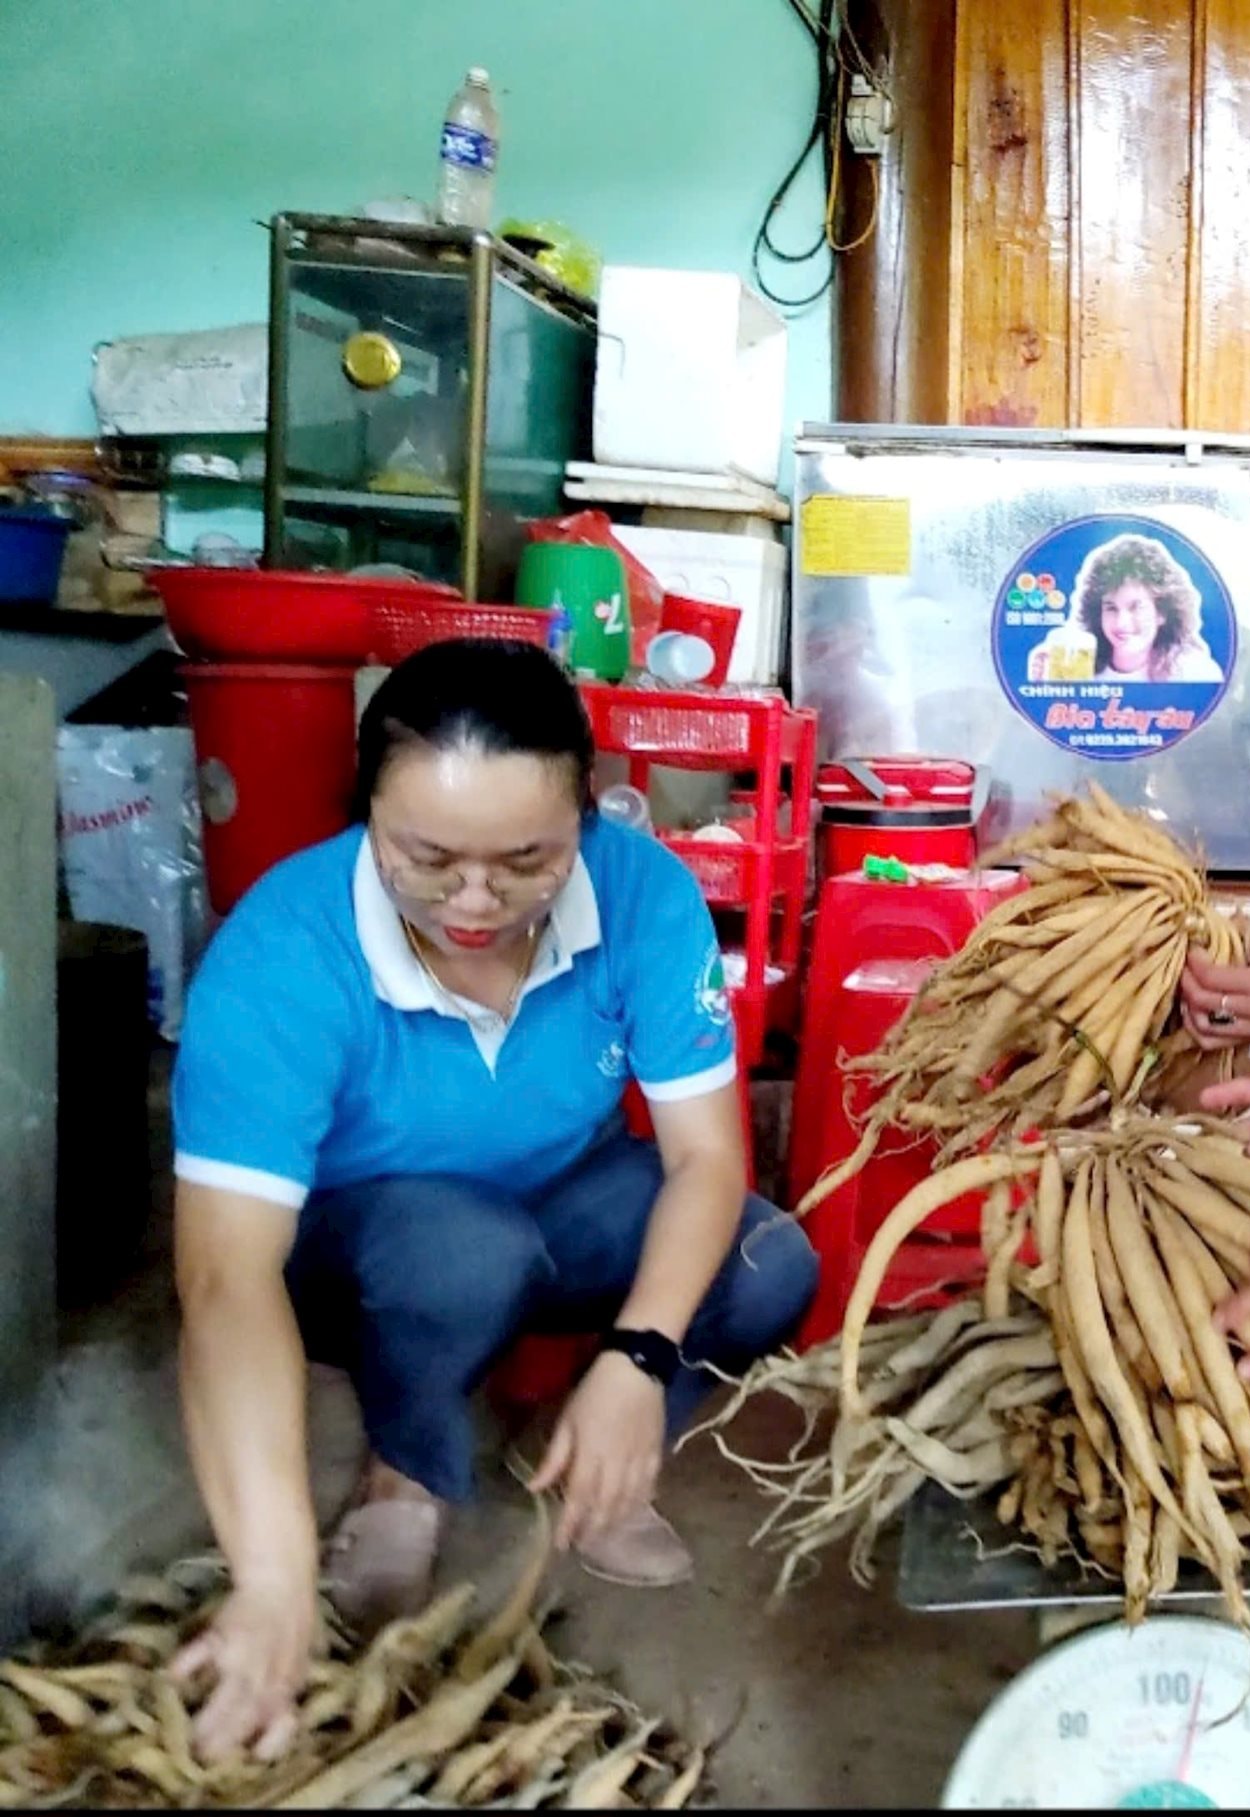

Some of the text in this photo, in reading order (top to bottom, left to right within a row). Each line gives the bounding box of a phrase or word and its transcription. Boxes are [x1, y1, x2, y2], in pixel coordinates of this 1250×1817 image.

[1018, 684, 1124, 699] CHÍNH HIỆU
[1045, 702, 1096, 730] Bia
[1138, 1671, 1190, 1705] 100
[1058, 1710, 1088, 1739] 90
